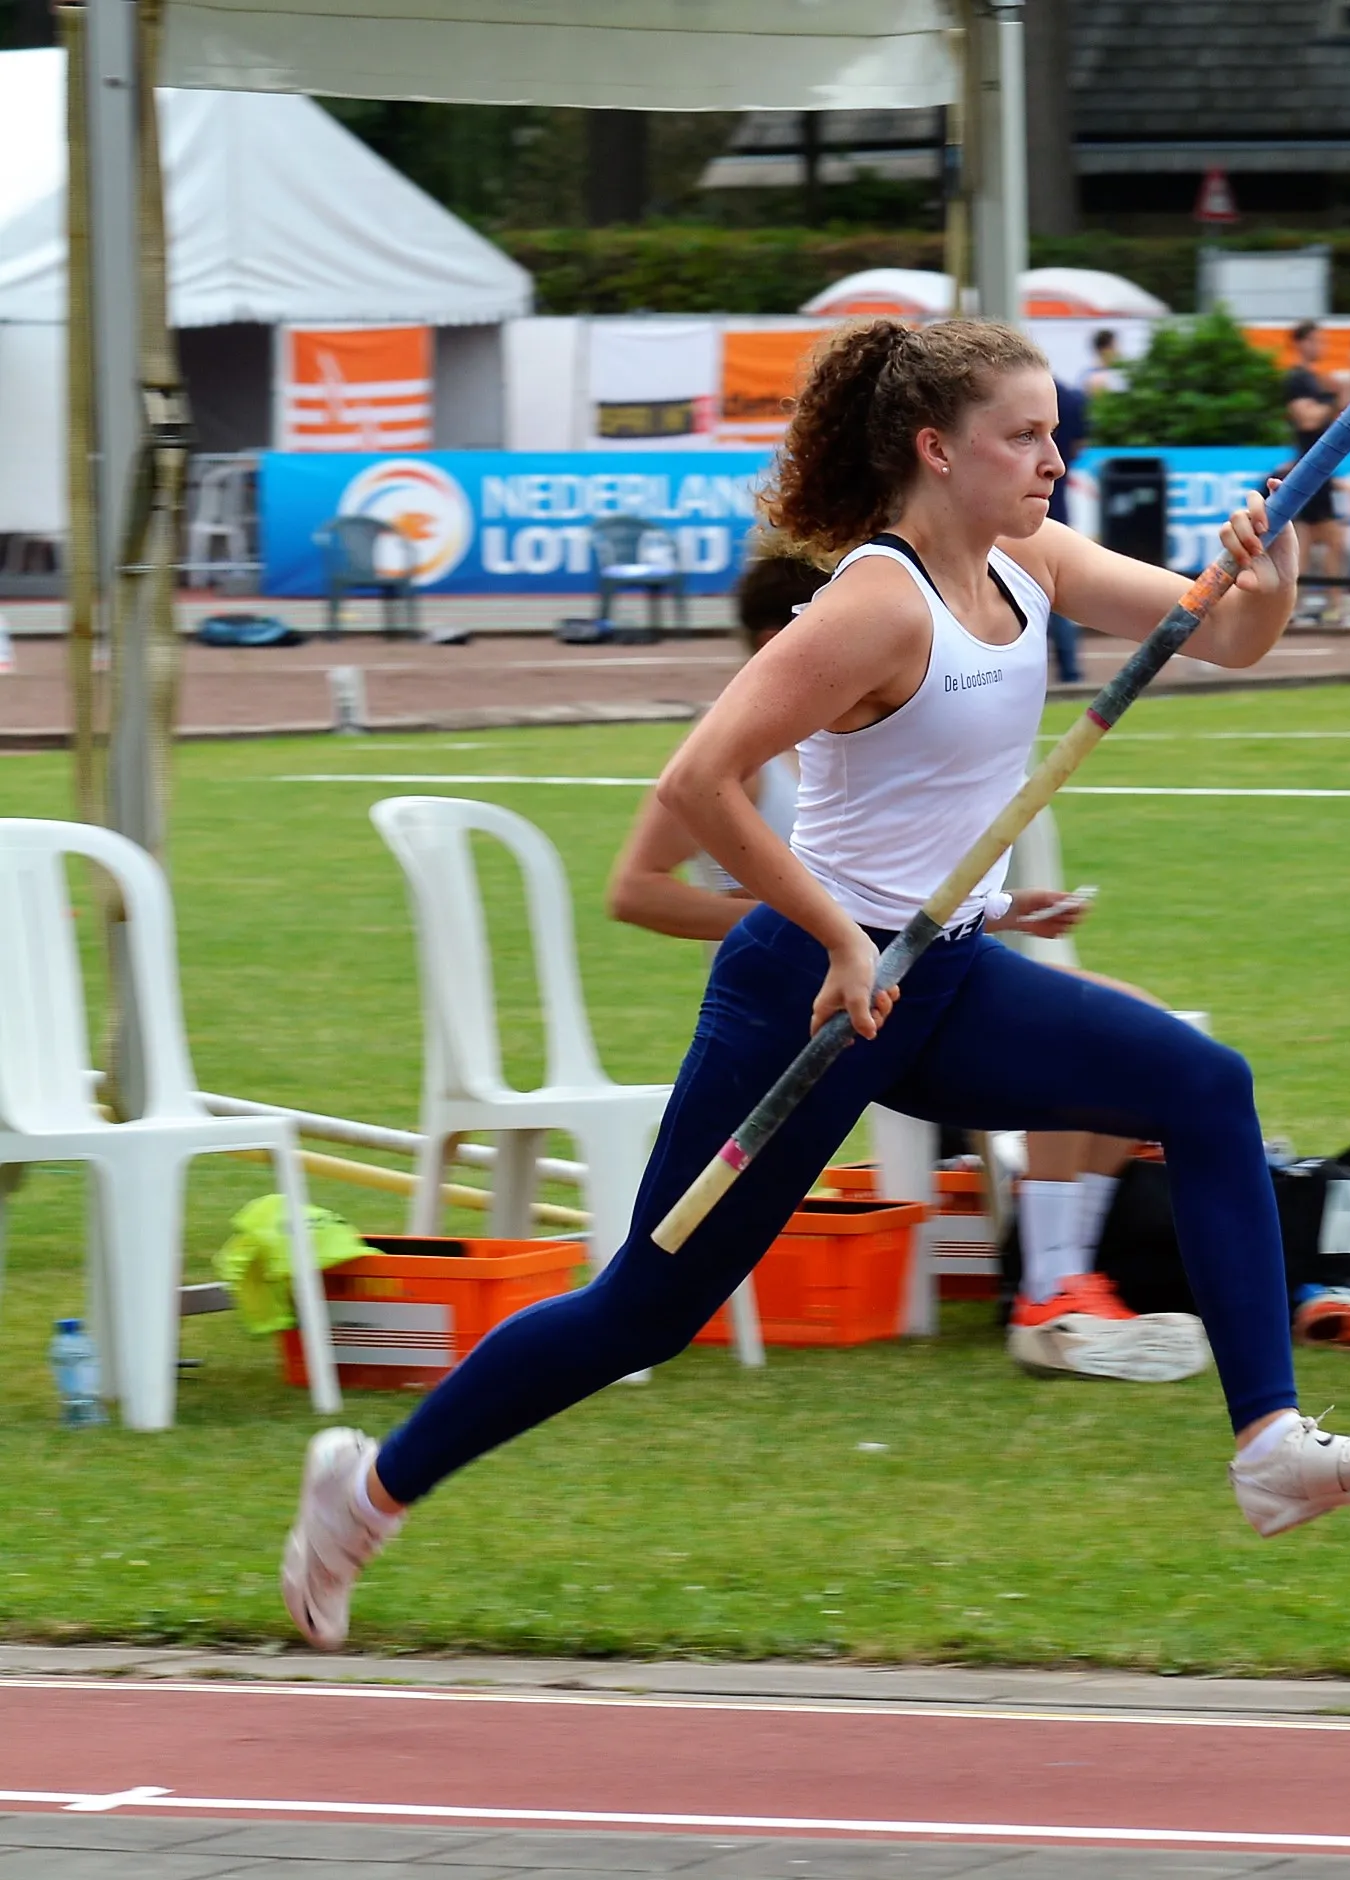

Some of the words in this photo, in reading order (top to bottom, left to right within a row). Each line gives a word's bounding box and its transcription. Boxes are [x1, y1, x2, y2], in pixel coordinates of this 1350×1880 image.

[482, 474, 756, 518] NEDERLAN
[482, 526, 729, 574] LOTIJ
[944, 674, 958, 692] De
[960, 668, 1003, 690] Loodsman
